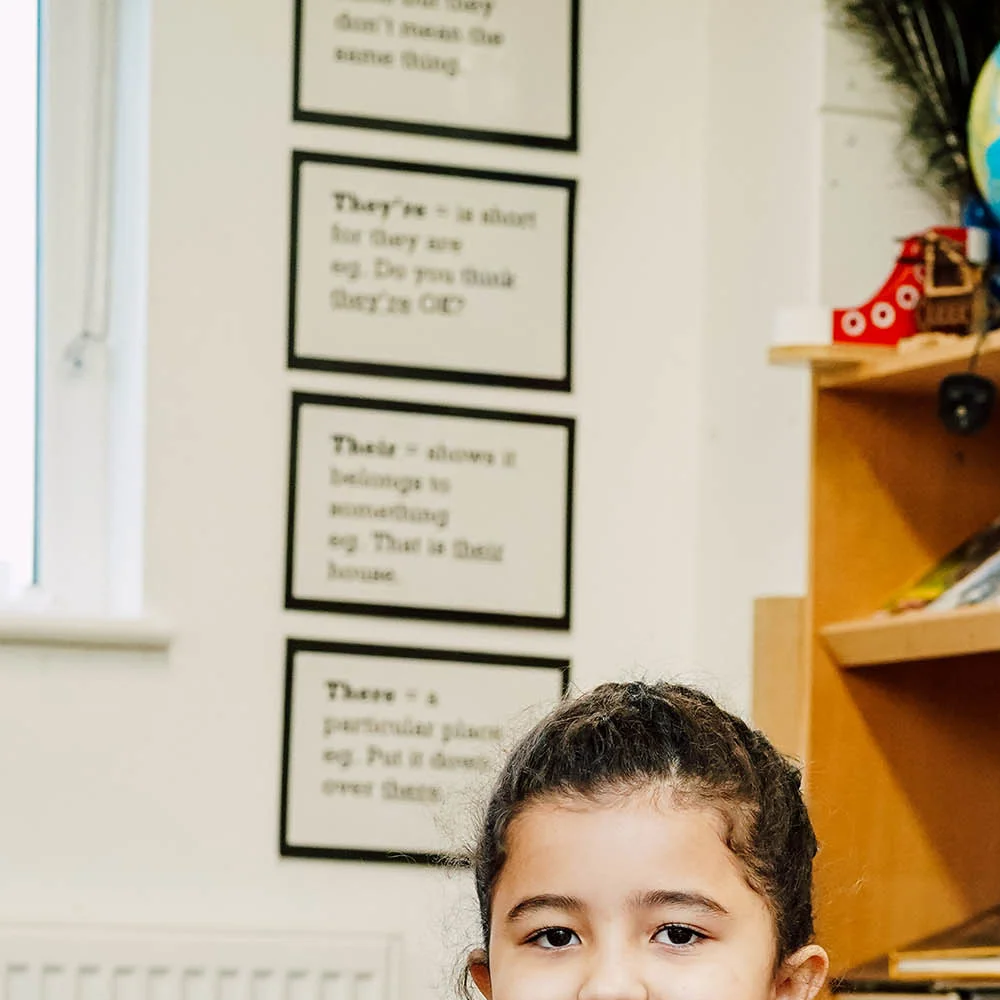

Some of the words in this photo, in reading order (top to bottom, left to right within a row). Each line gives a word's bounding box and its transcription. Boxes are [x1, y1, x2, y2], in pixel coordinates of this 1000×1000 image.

[468, 26, 505, 46] the
[334, 47, 394, 66] same
[332, 191, 428, 222] They're
[457, 205, 474, 222] is
[480, 206, 537, 229] short
[331, 222, 361, 245] for
[370, 227, 419, 254] they
[428, 235, 463, 251] are
[373, 256, 406, 279] Do
[413, 263, 455, 289] you
[460, 266, 516, 289] think
[331, 434, 396, 457] Their
[427, 442, 495, 464] shows
[330, 466, 421, 494] belongs
[428, 475, 452, 493] to
[329, 501, 450, 529] something
[371, 530, 422, 556] That
[427, 538, 446, 557] is
[452, 536, 504, 562] their
[325, 679, 397, 703] There
[426, 689, 440, 707] a
[323, 715, 434, 739] particular
[366, 743, 404, 767] Put
[321, 780, 373, 798] over
